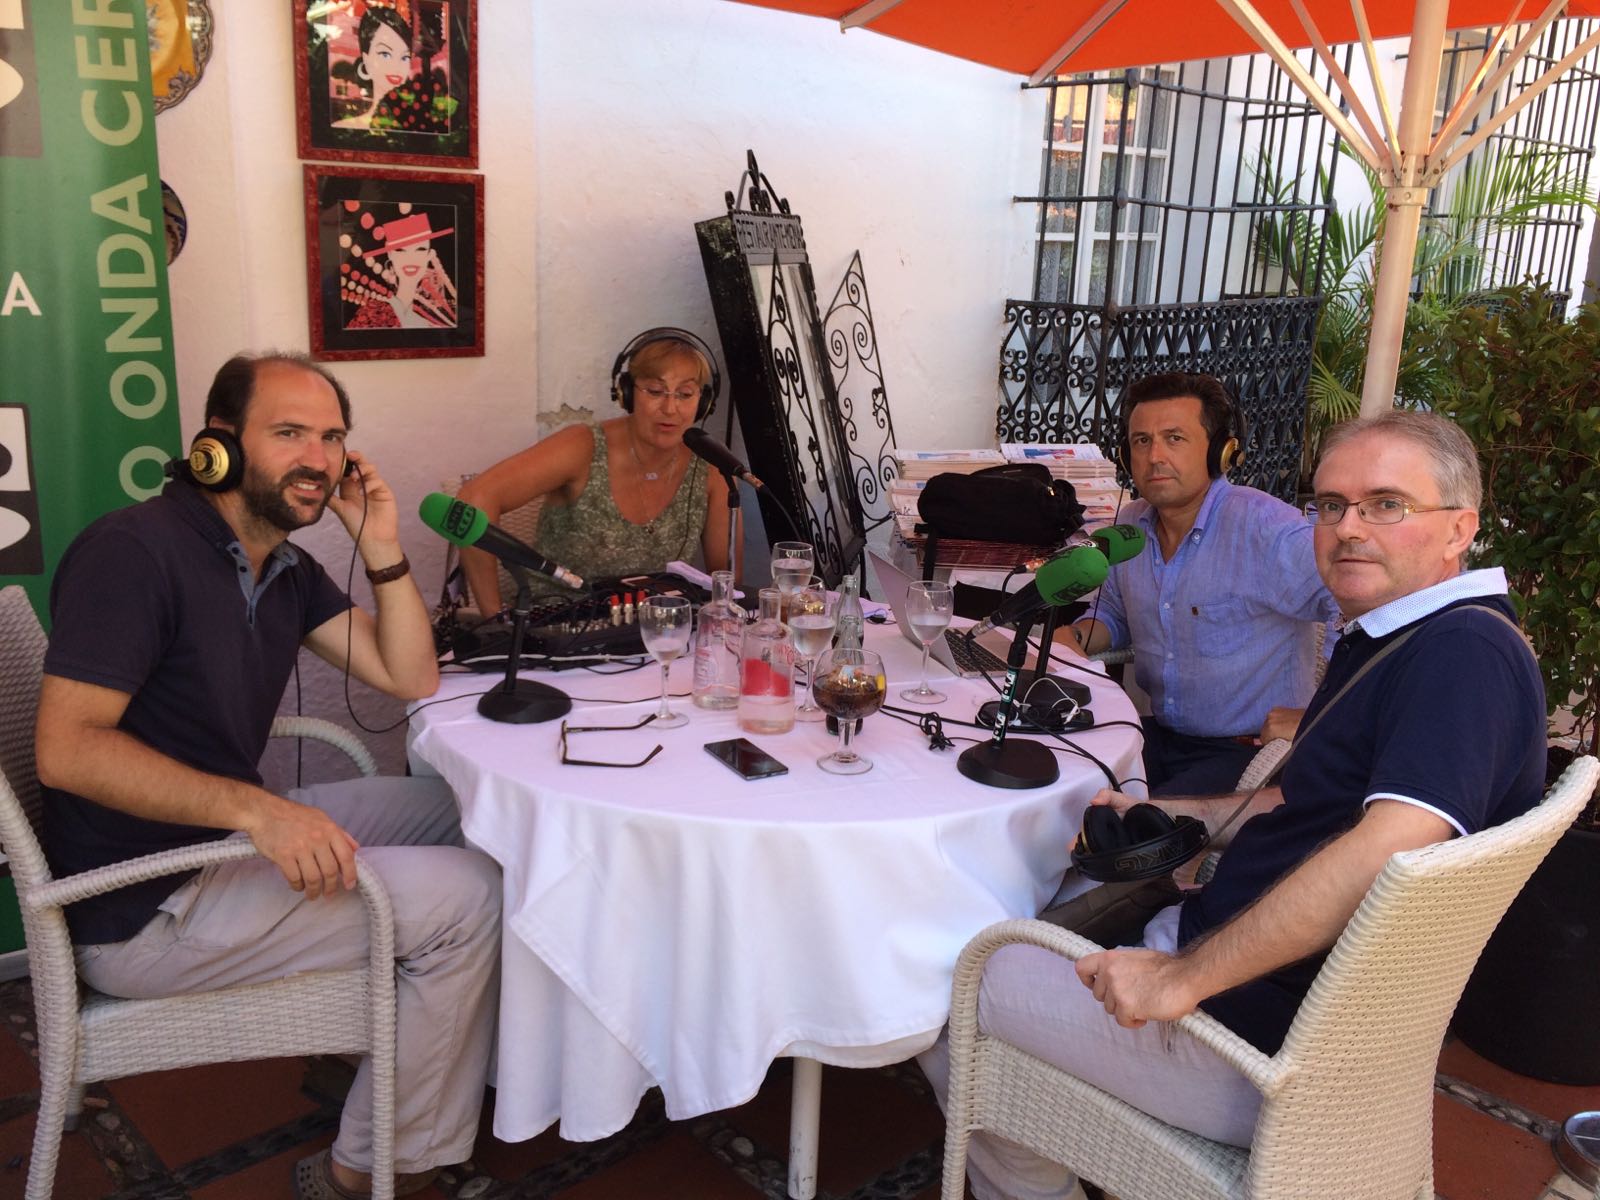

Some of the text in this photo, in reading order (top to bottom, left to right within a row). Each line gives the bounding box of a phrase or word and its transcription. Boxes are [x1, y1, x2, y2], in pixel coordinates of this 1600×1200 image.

[72, 0, 143, 147] CER
[0, 271, 42, 316] A
[90, 174, 167, 420] ONDA
[1114, 839, 1183, 872] AKG
